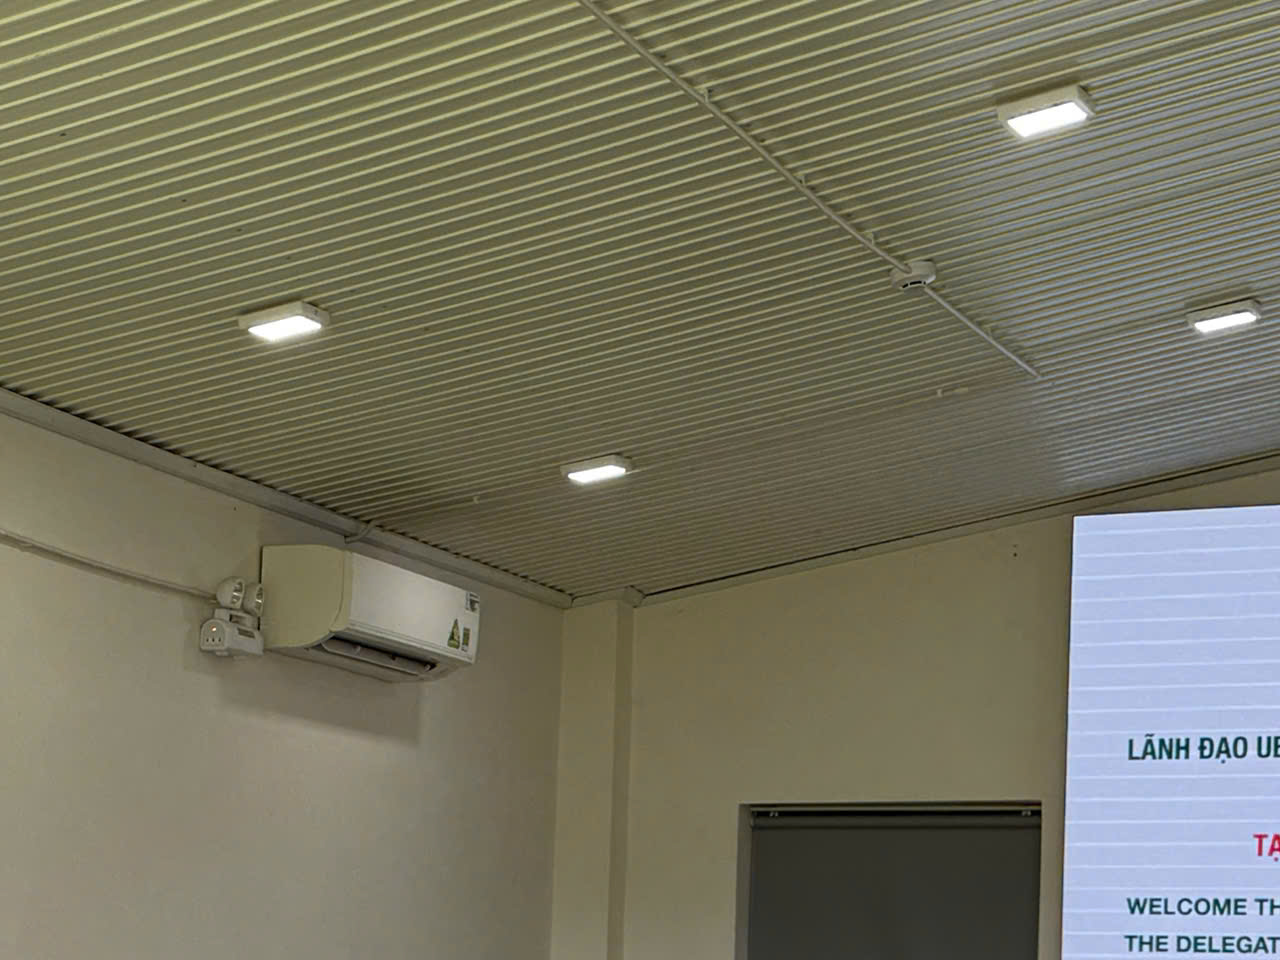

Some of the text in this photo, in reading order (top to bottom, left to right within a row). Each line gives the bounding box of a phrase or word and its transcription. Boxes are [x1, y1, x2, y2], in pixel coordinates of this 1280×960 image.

[1128, 733, 1190, 760] LÃNH
[1198, 736, 1248, 764] ĐẠO
[1253, 833, 1280, 862] TẠ
[1126, 898, 1280, 916] WELCOME TH
[1125, 935, 1280, 954] THE DELEGAT
